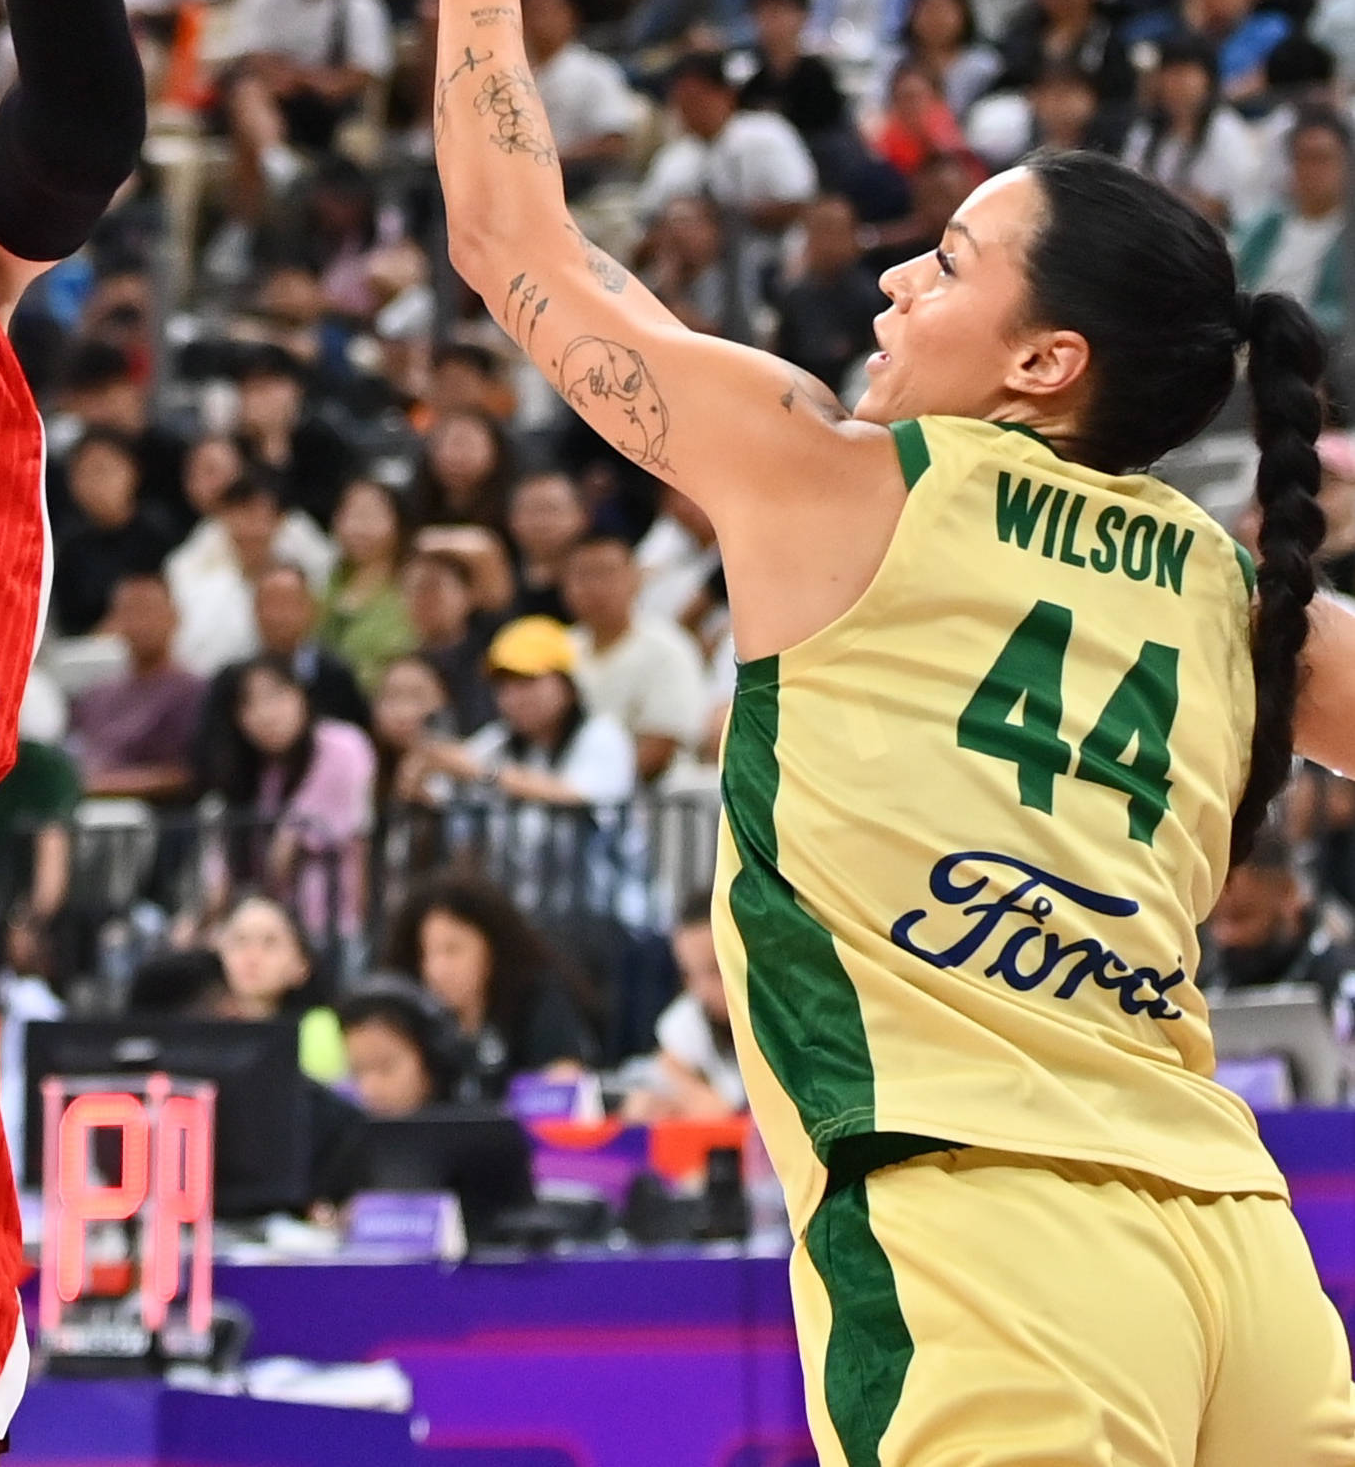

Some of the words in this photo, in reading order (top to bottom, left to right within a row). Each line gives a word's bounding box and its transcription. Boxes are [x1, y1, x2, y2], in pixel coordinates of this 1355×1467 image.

[996, 471, 1194, 596] WILSON
[957, 599, 1180, 848] 44
[890, 851, 1185, 1020] Ford
